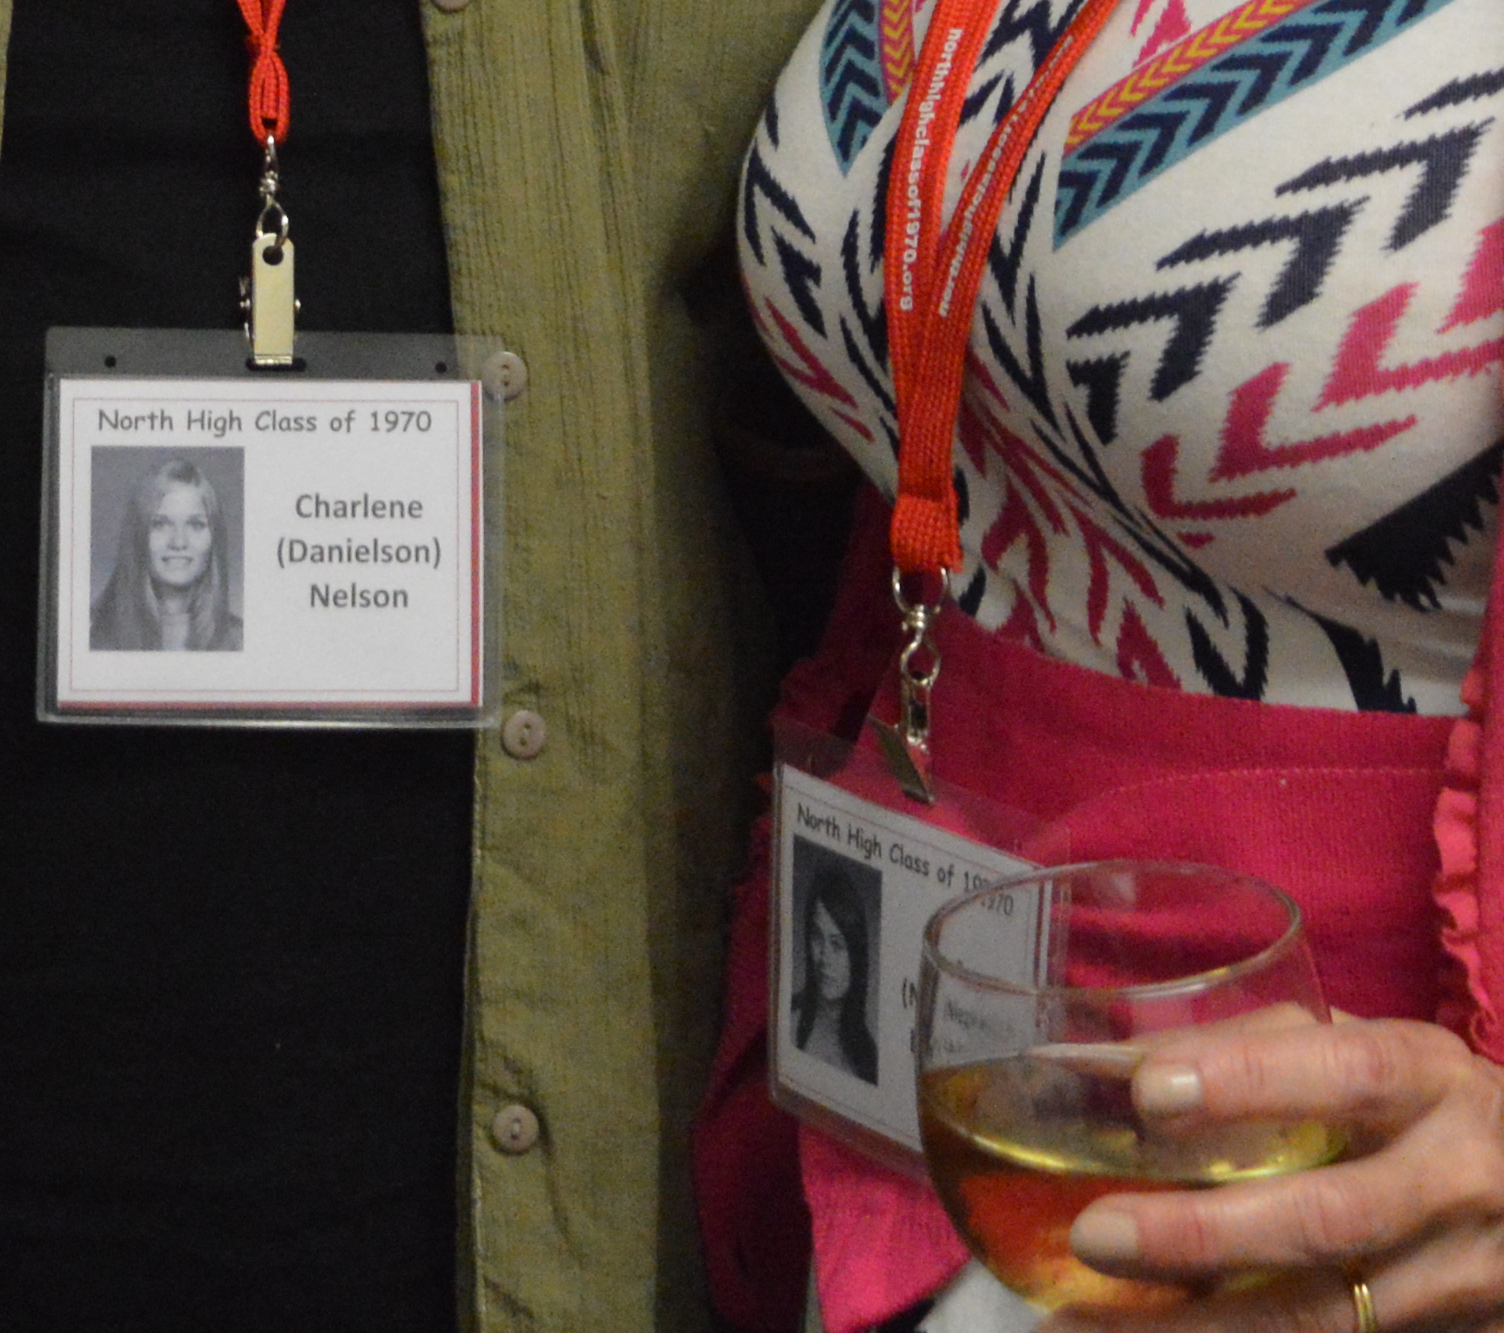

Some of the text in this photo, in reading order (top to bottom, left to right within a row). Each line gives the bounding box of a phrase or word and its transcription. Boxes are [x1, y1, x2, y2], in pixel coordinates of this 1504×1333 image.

[898, 26, 963, 312] northhighclassof1970.org
[97, 408, 432, 437] North High Class of 1970
[295, 494, 424, 520] Charlene
[276, 537, 442, 570] (Danielson)
[309, 583, 409, 609] Nelson
[796, 802, 842, 839] North
[847, 826, 883, 860] High
[889, 843, 930, 877] Class
[937, 864, 955, 888] of
